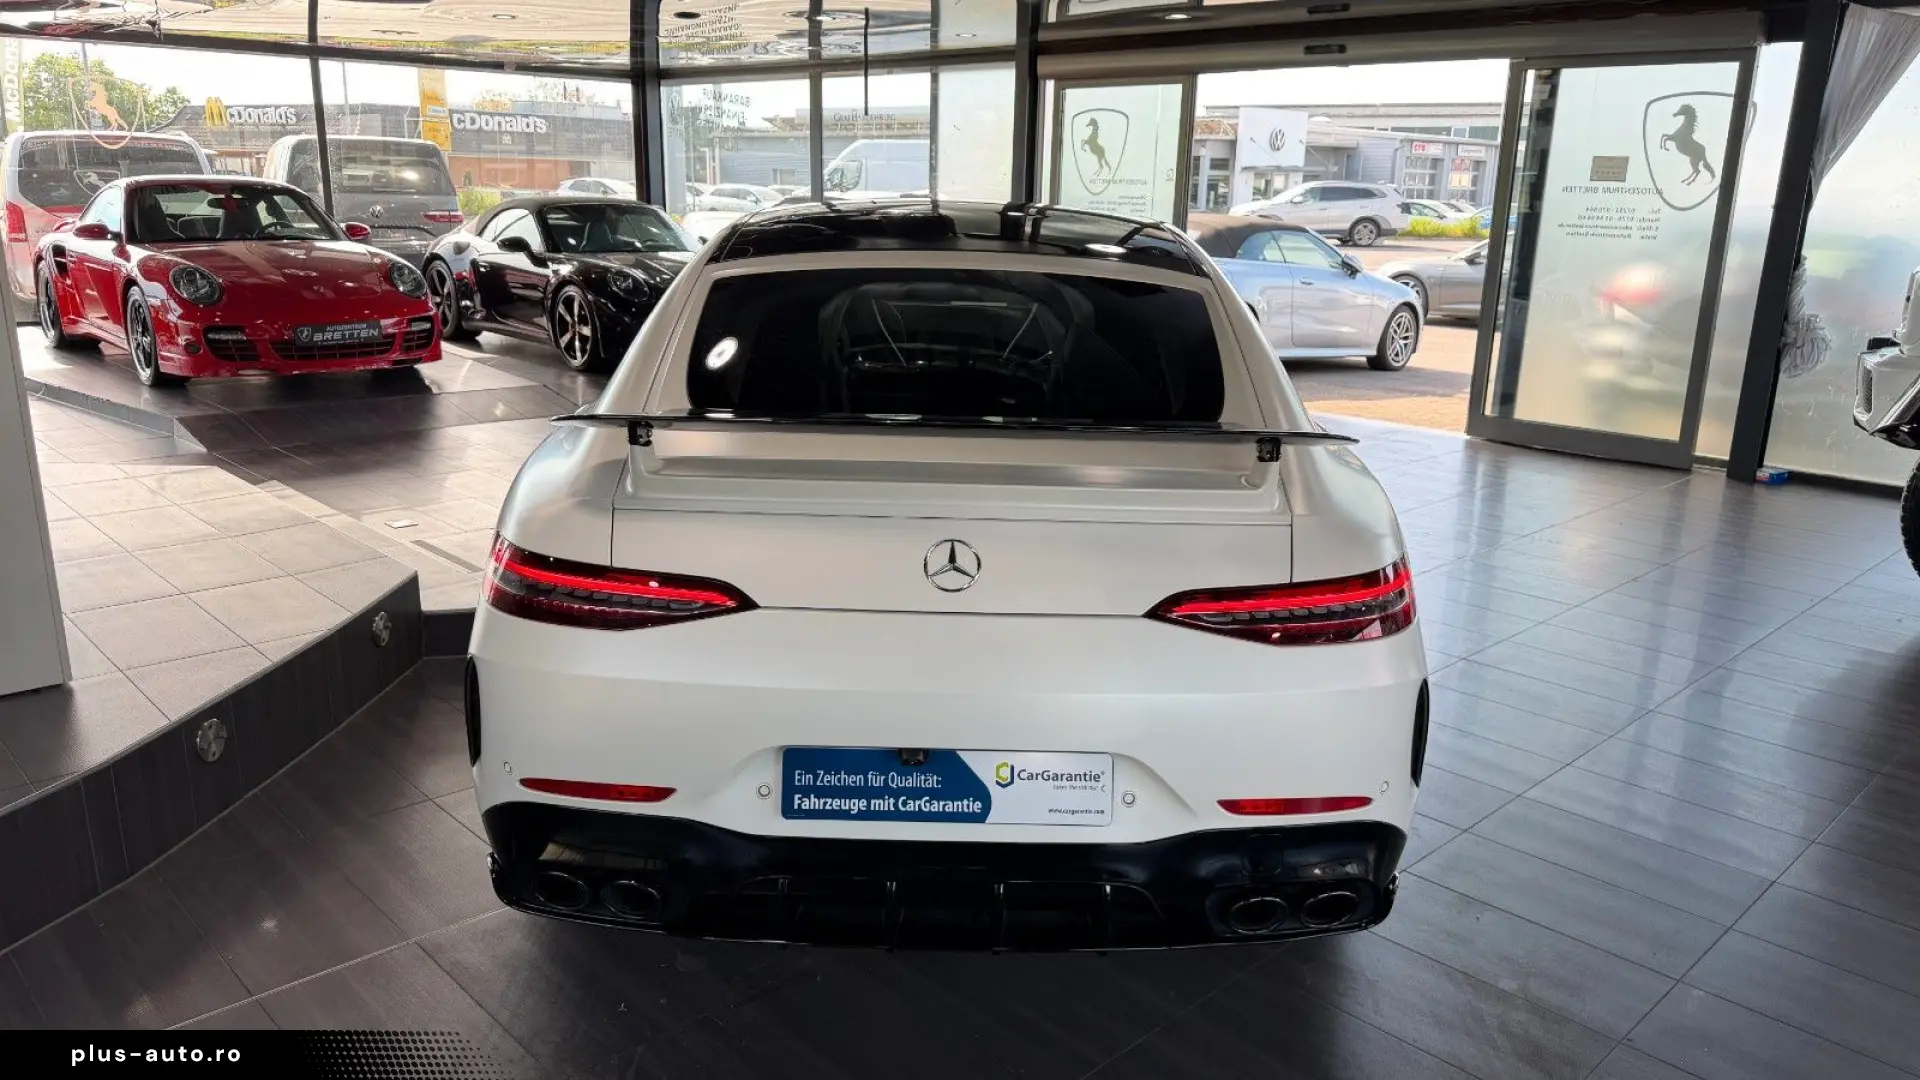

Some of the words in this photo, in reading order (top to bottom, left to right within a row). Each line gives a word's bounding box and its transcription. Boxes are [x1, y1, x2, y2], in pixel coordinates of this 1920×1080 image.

[313, 328, 379, 341] BRETTEN
[794, 770, 813, 786] Ein
[816, 770, 865, 787] Zeichen
[867, 771, 886, 787] für
[888, 771, 942, 789] Qualität:
[1017, 769, 1101, 783] CarGarantie
[793, 794, 867, 814] Fahrzeuge
[870, 795, 895, 811] mit
[898, 796, 982, 813] CarGarantie
